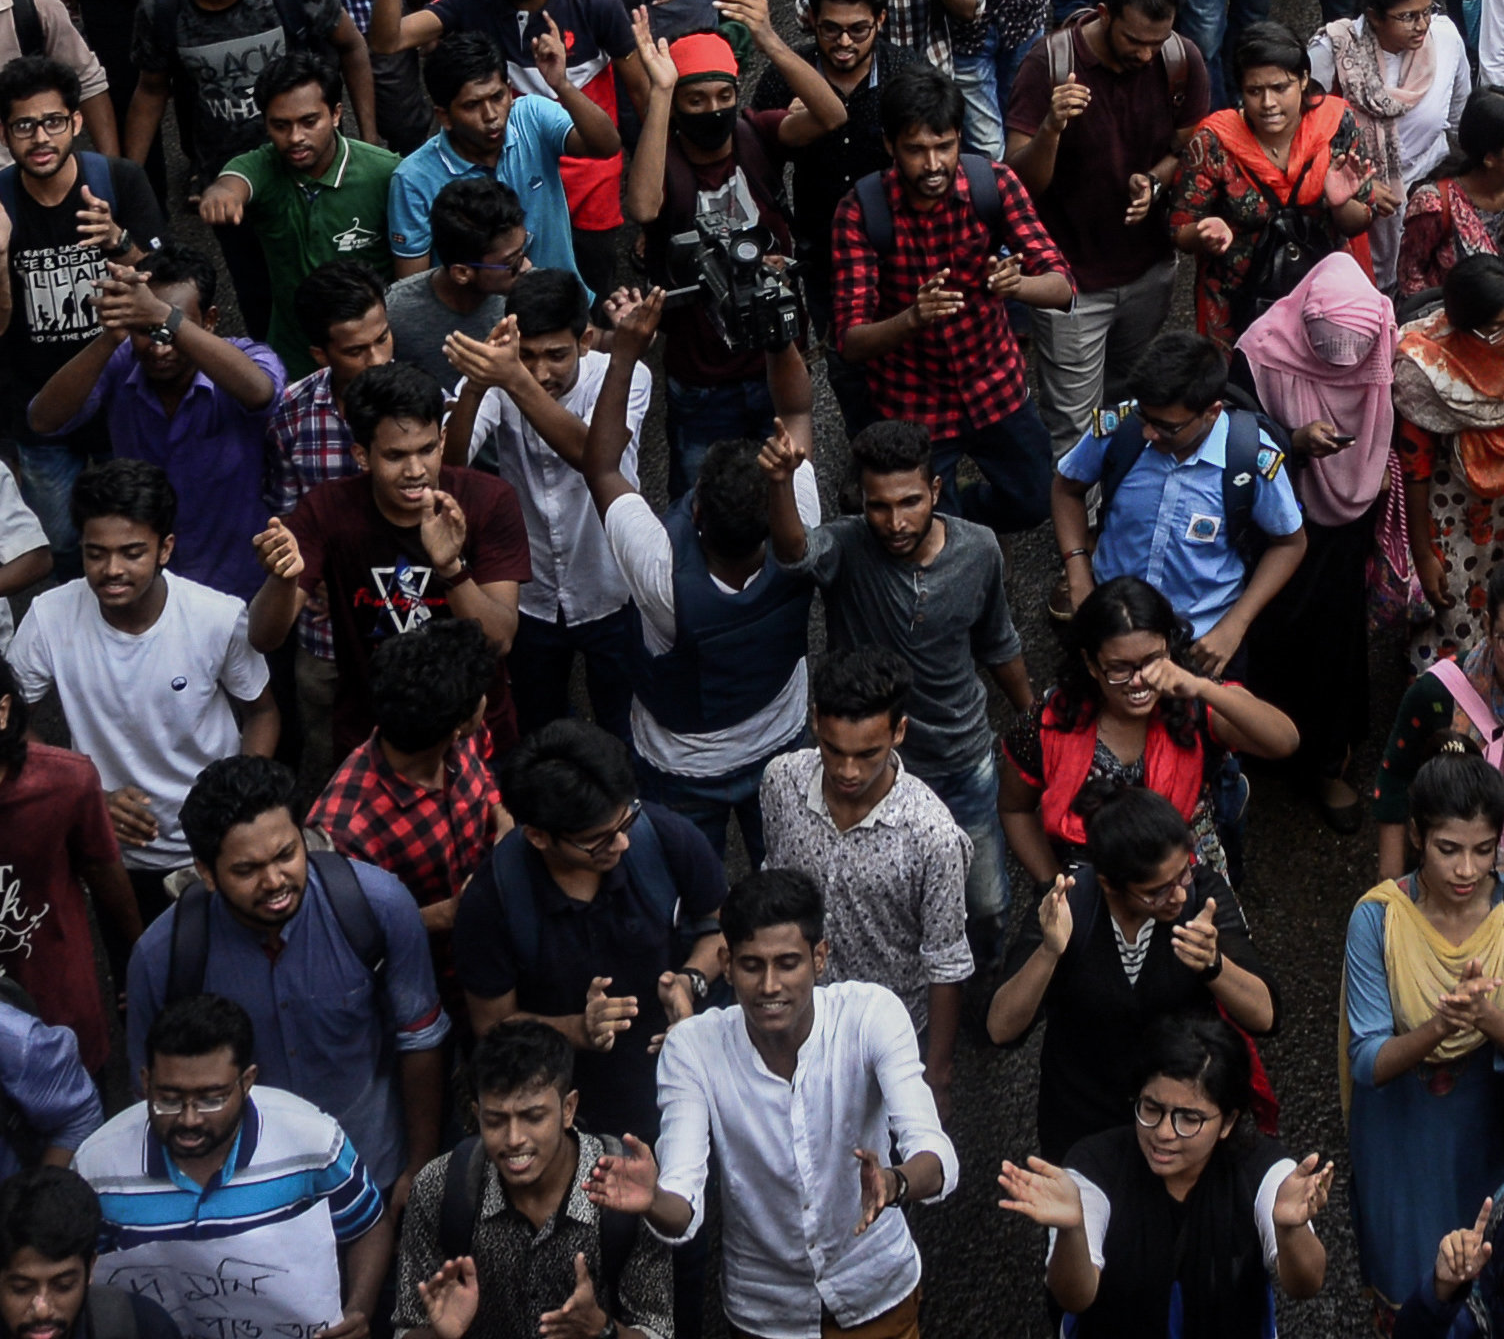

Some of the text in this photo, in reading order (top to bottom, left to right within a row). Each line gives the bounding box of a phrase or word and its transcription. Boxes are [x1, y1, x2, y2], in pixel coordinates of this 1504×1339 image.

[43, 257, 56, 269] &
[57, 249, 101, 265] DEAT
[27, 261, 110, 290] LLAH
[82, 324, 105, 340] WOR
